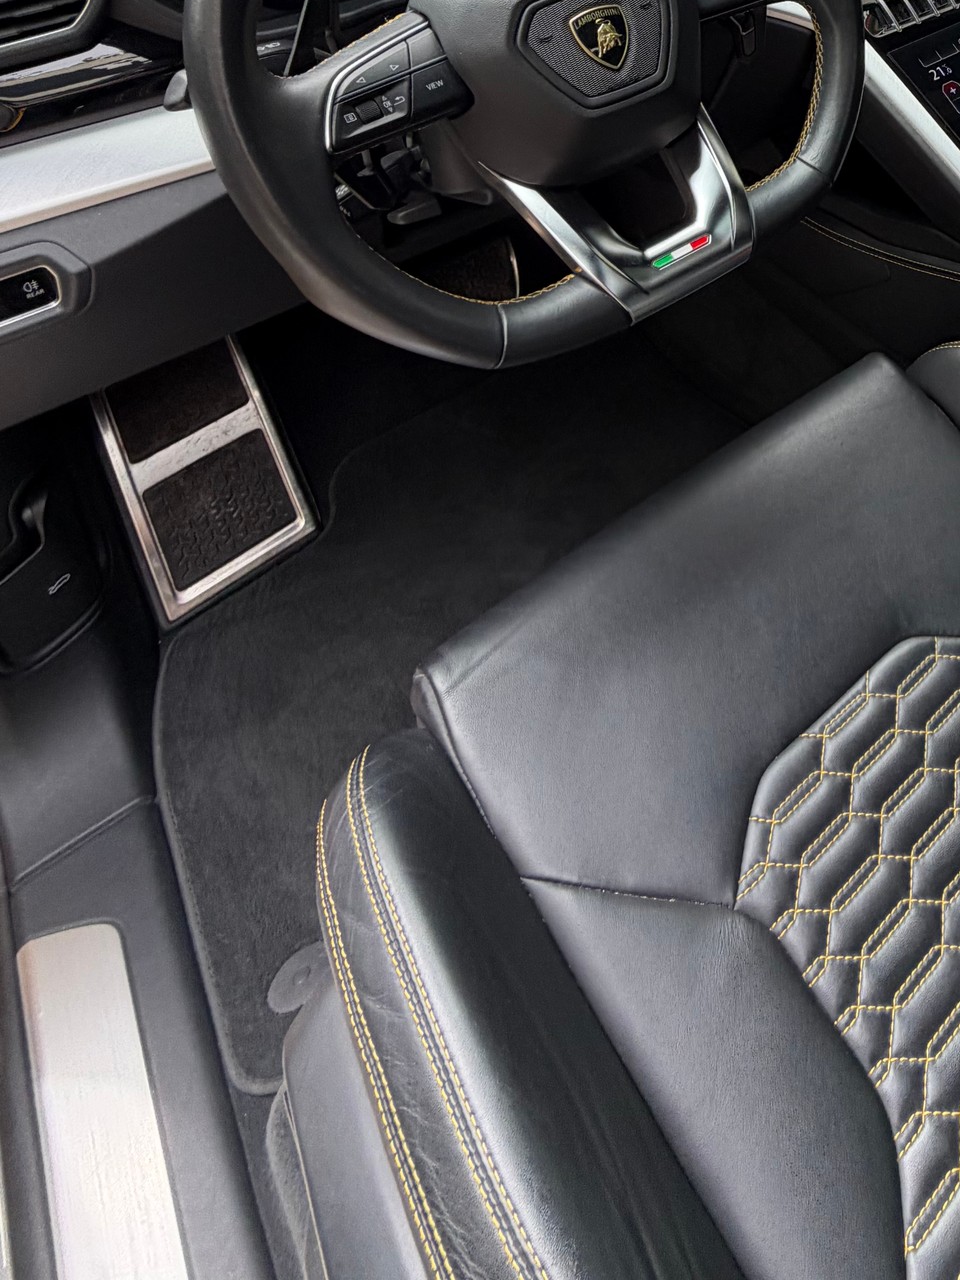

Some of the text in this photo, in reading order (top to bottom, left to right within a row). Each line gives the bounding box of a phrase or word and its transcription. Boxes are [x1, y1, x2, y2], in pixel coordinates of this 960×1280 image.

[573, 8, 620, 30] LAMBORGHINI
[426, 80, 444, 91] VIEW
[383, 100, 392, 108] OK
[26, 288, 45, 299] REAR
